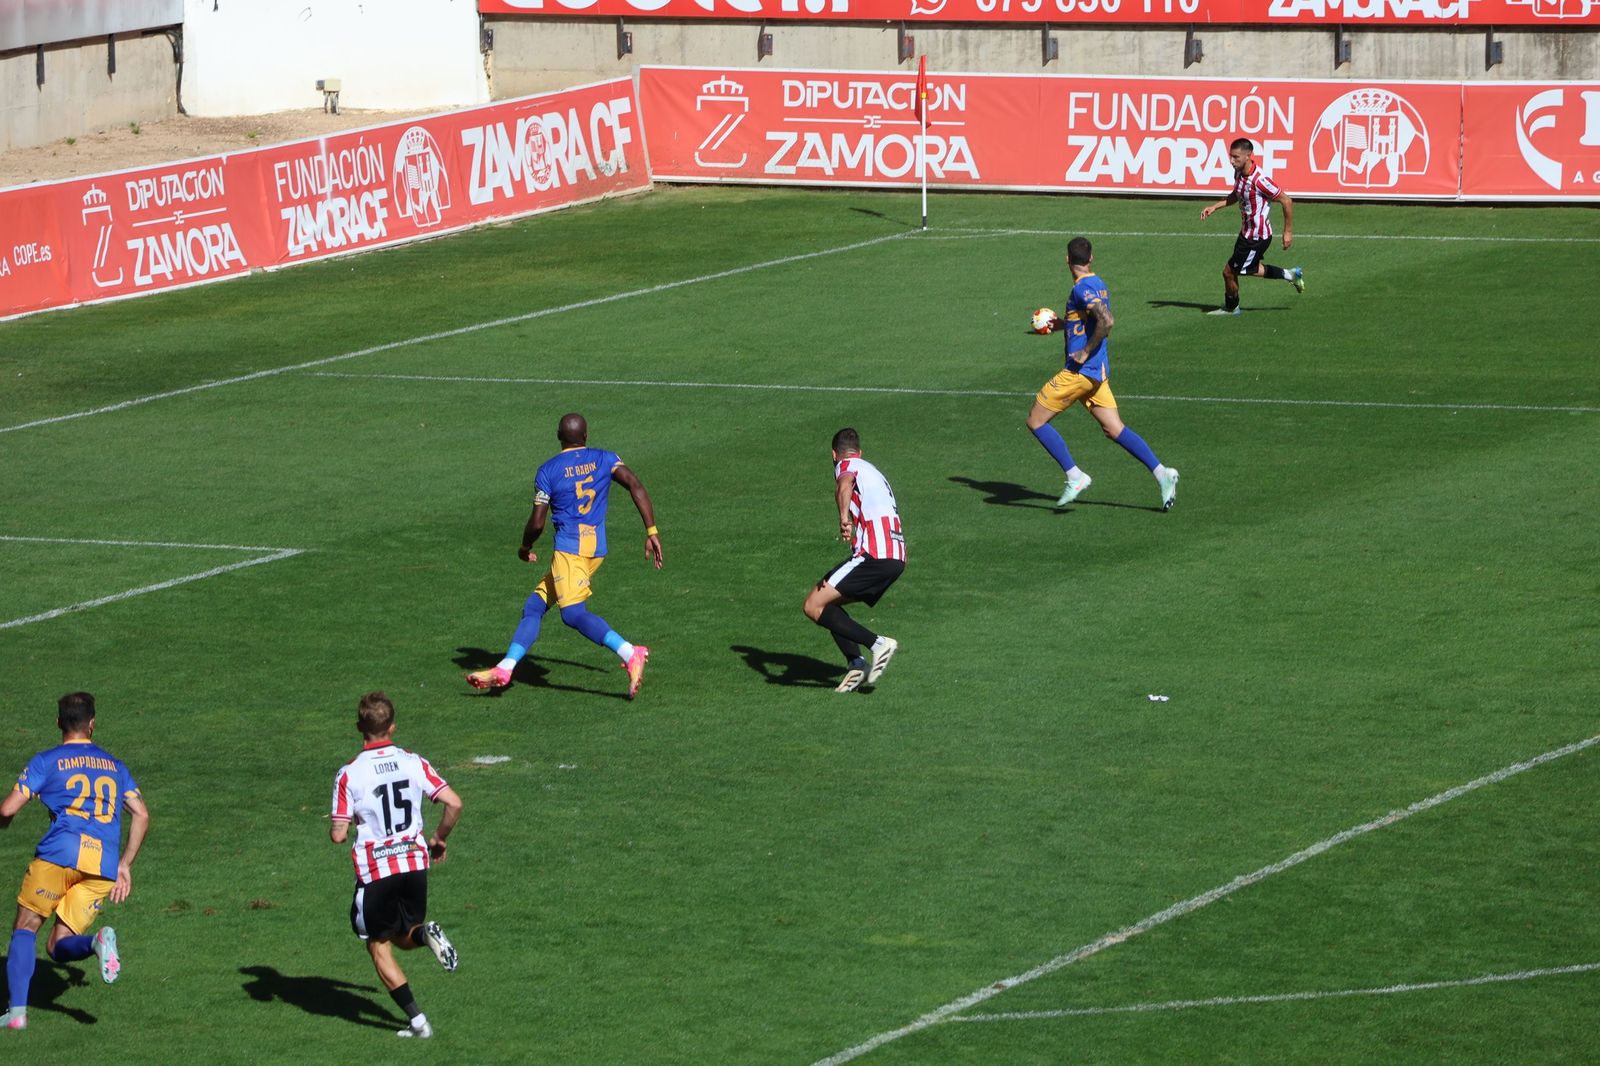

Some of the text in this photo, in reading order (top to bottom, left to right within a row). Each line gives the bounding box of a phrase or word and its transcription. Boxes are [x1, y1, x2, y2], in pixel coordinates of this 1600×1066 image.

[1067, 86, 1295, 134] FUNDACIÓN
[273, 135, 386, 203] FUNDACIÓN
[460, 107, 598, 206] ZAMORA
[764, 131, 981, 180] ZAMORA
[13, 242, 52, 267] COPE.es
[126, 222, 249, 287] ZAMORA
[574, 475, 597, 516] 5
[57, 755, 119, 773] CAMPABADAL
[373, 760, 400, 776] LOREN
[65, 772, 119, 824] 20
[371, 778, 413, 837] 15
